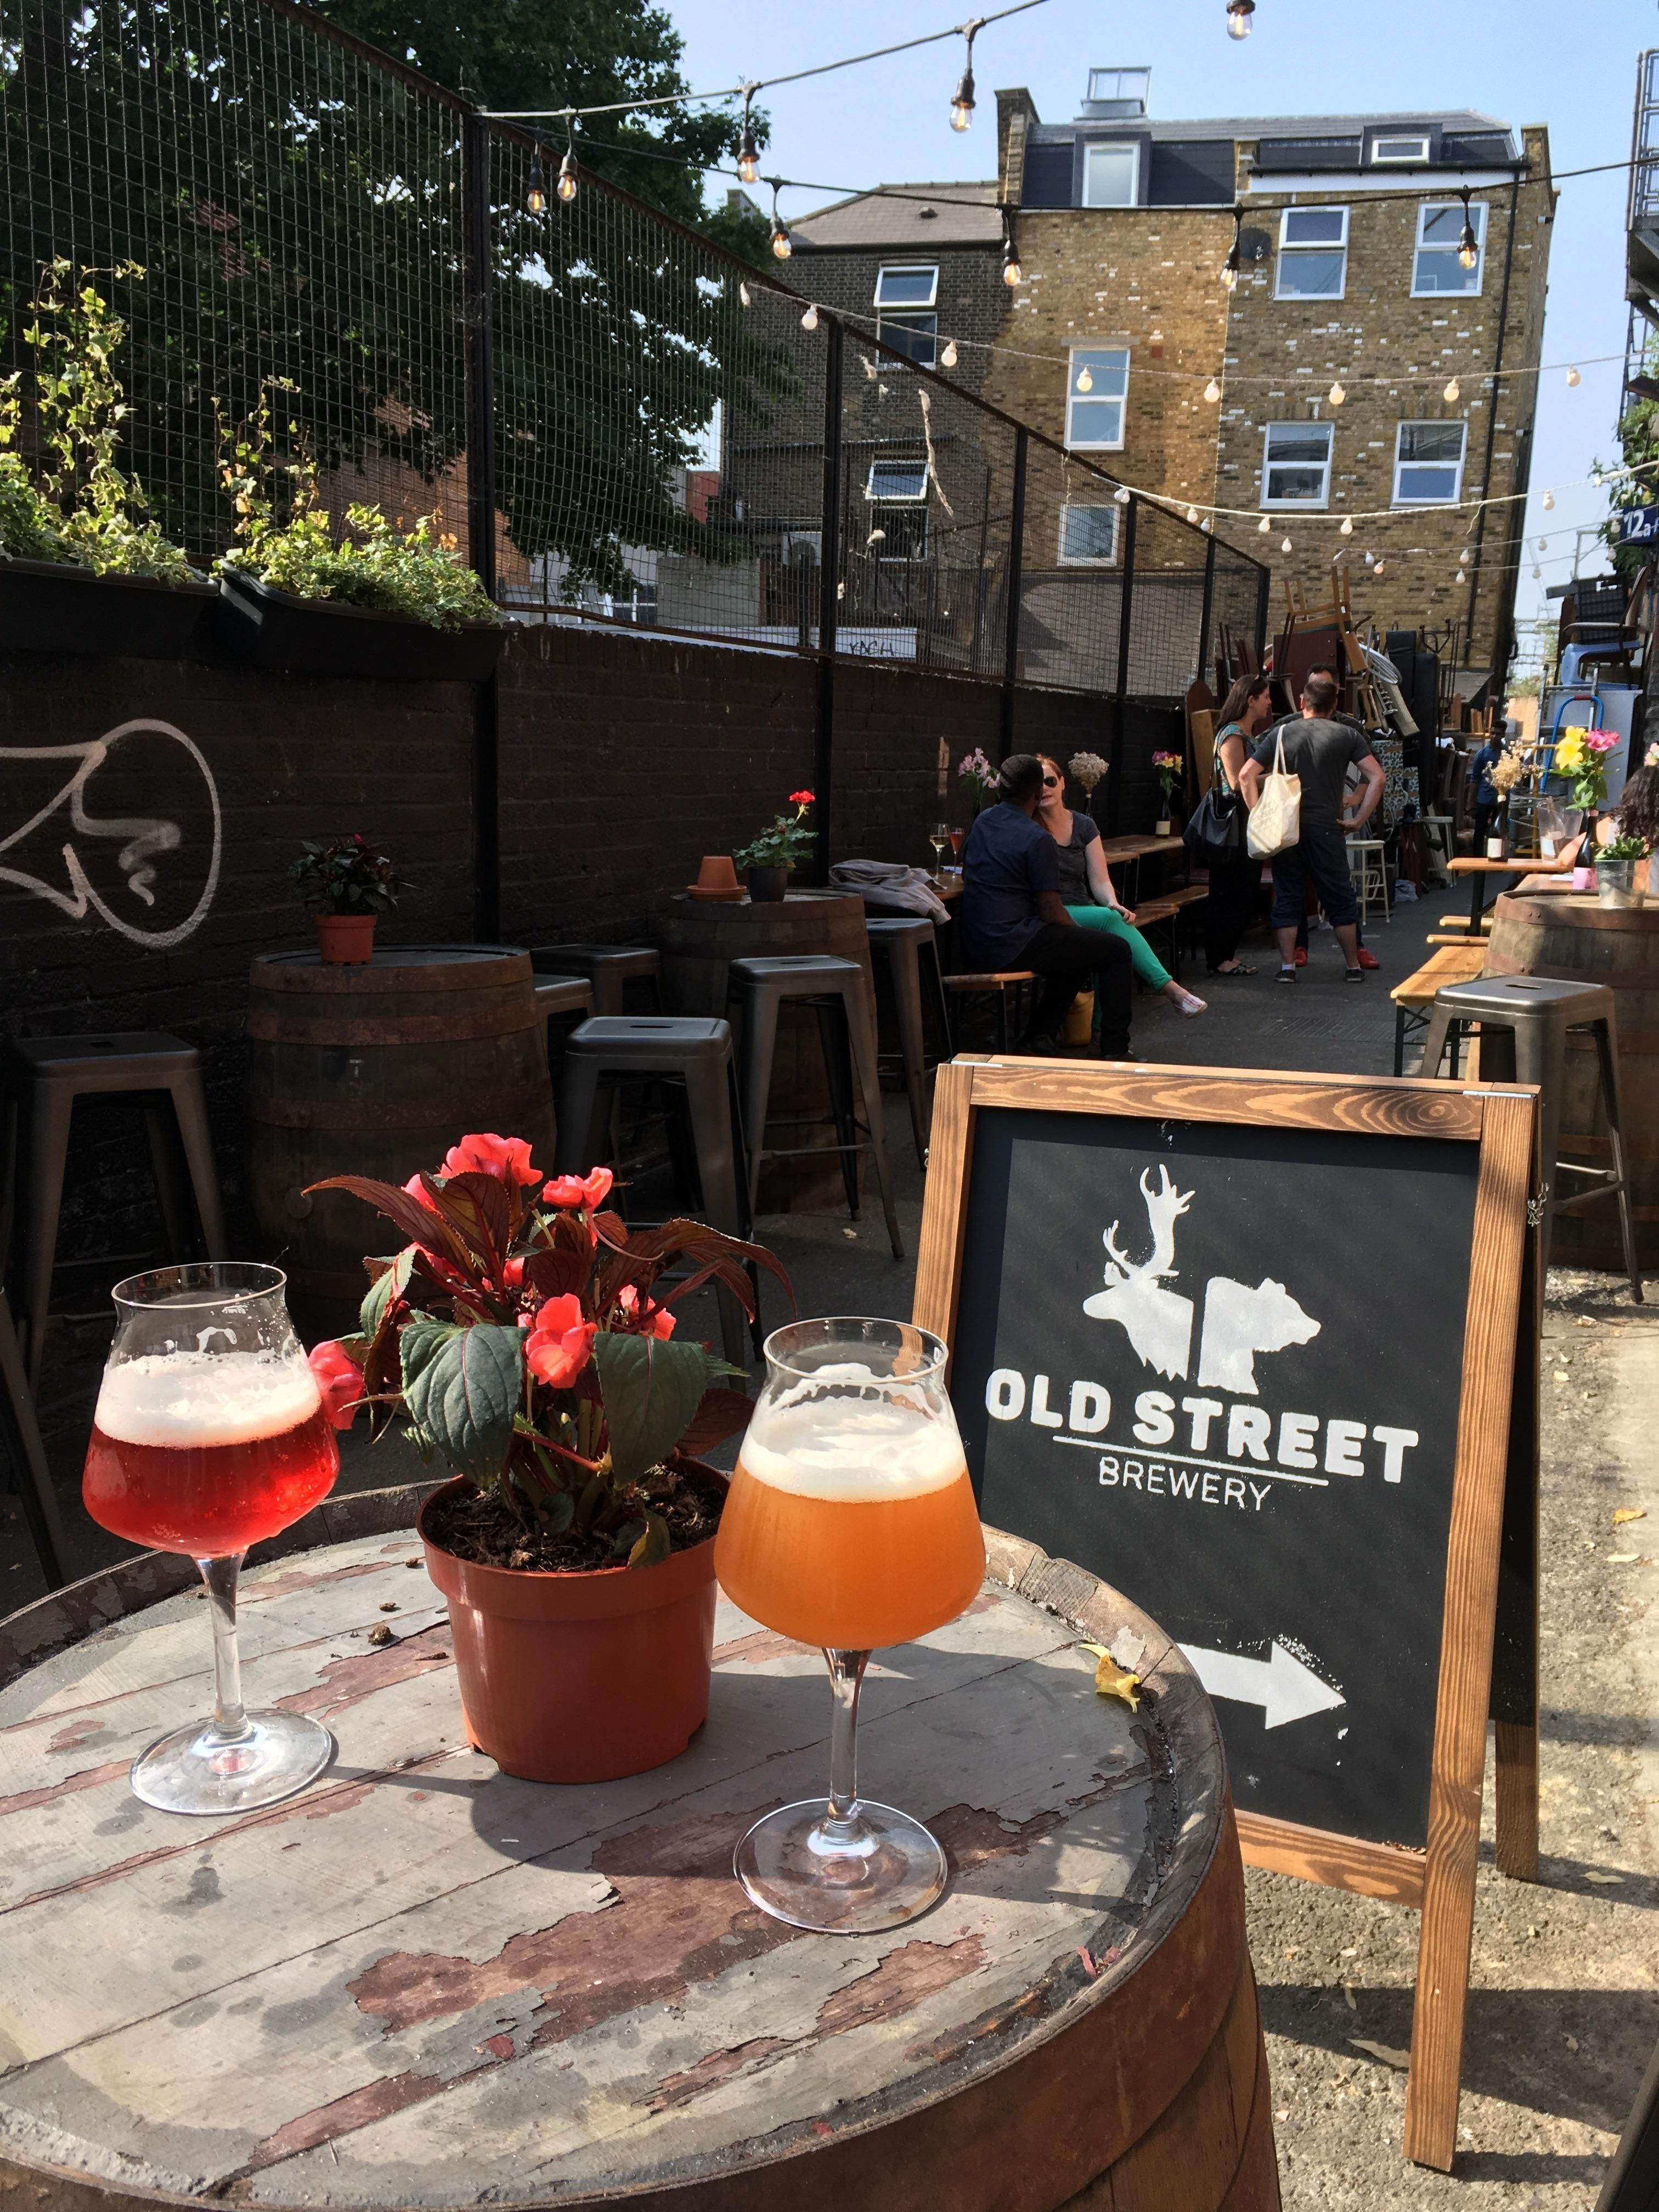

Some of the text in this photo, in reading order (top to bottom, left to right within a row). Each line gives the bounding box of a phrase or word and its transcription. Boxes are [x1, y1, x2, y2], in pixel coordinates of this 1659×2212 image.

[986, 1368, 1419, 1483] OLD STREET
[1099, 1456, 1272, 1510] BREWERY
